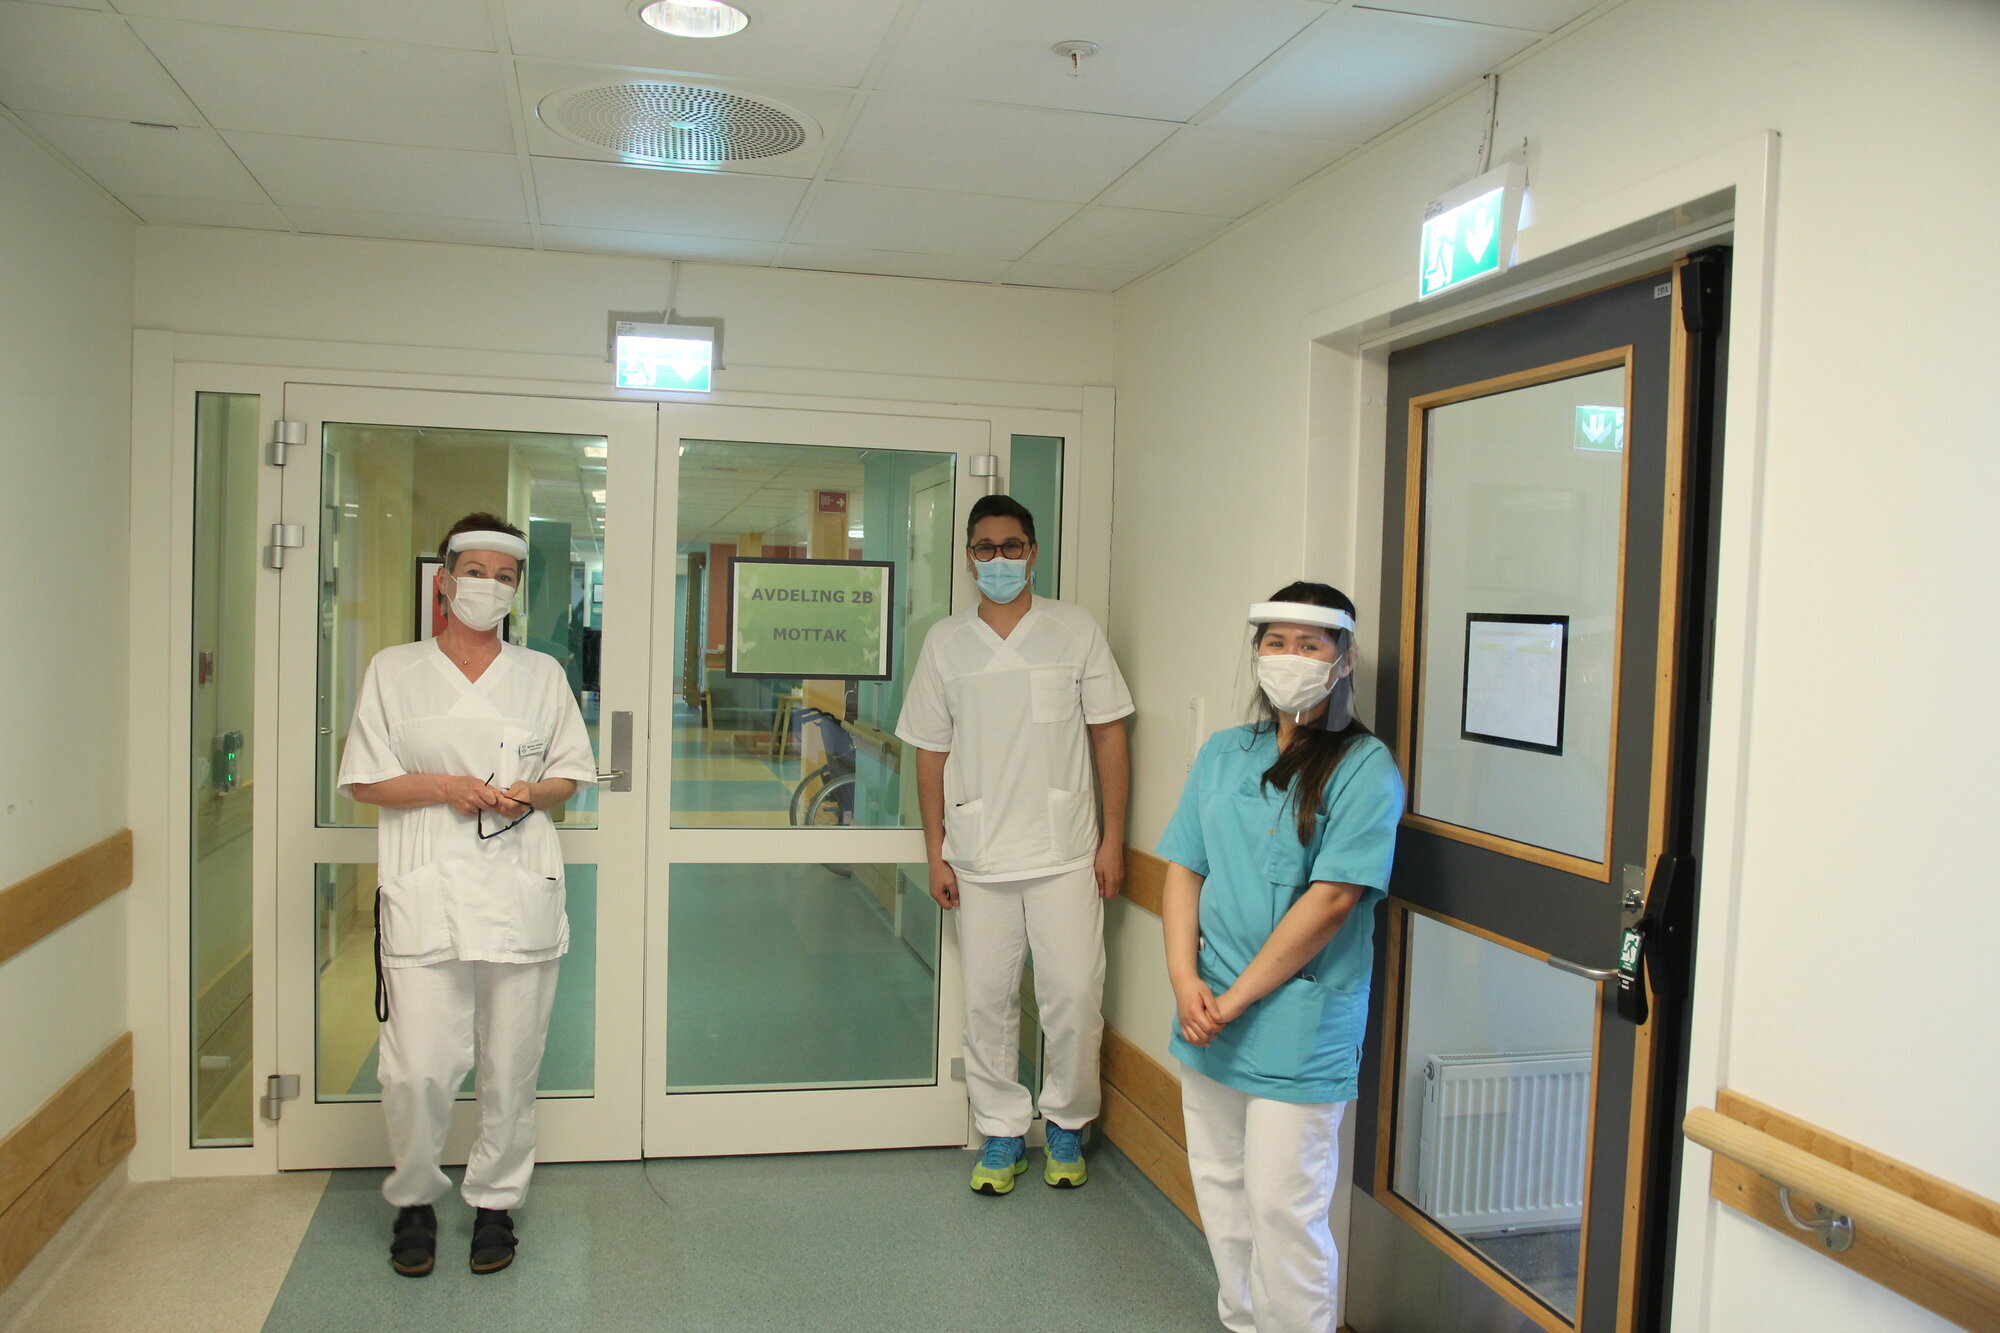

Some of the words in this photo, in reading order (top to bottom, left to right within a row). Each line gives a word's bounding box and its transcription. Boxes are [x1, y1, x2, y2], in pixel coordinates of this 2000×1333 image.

[752, 588, 845, 603] AVDELING
[851, 591, 874, 604] 2B
[773, 627, 848, 642] MOTTAK
